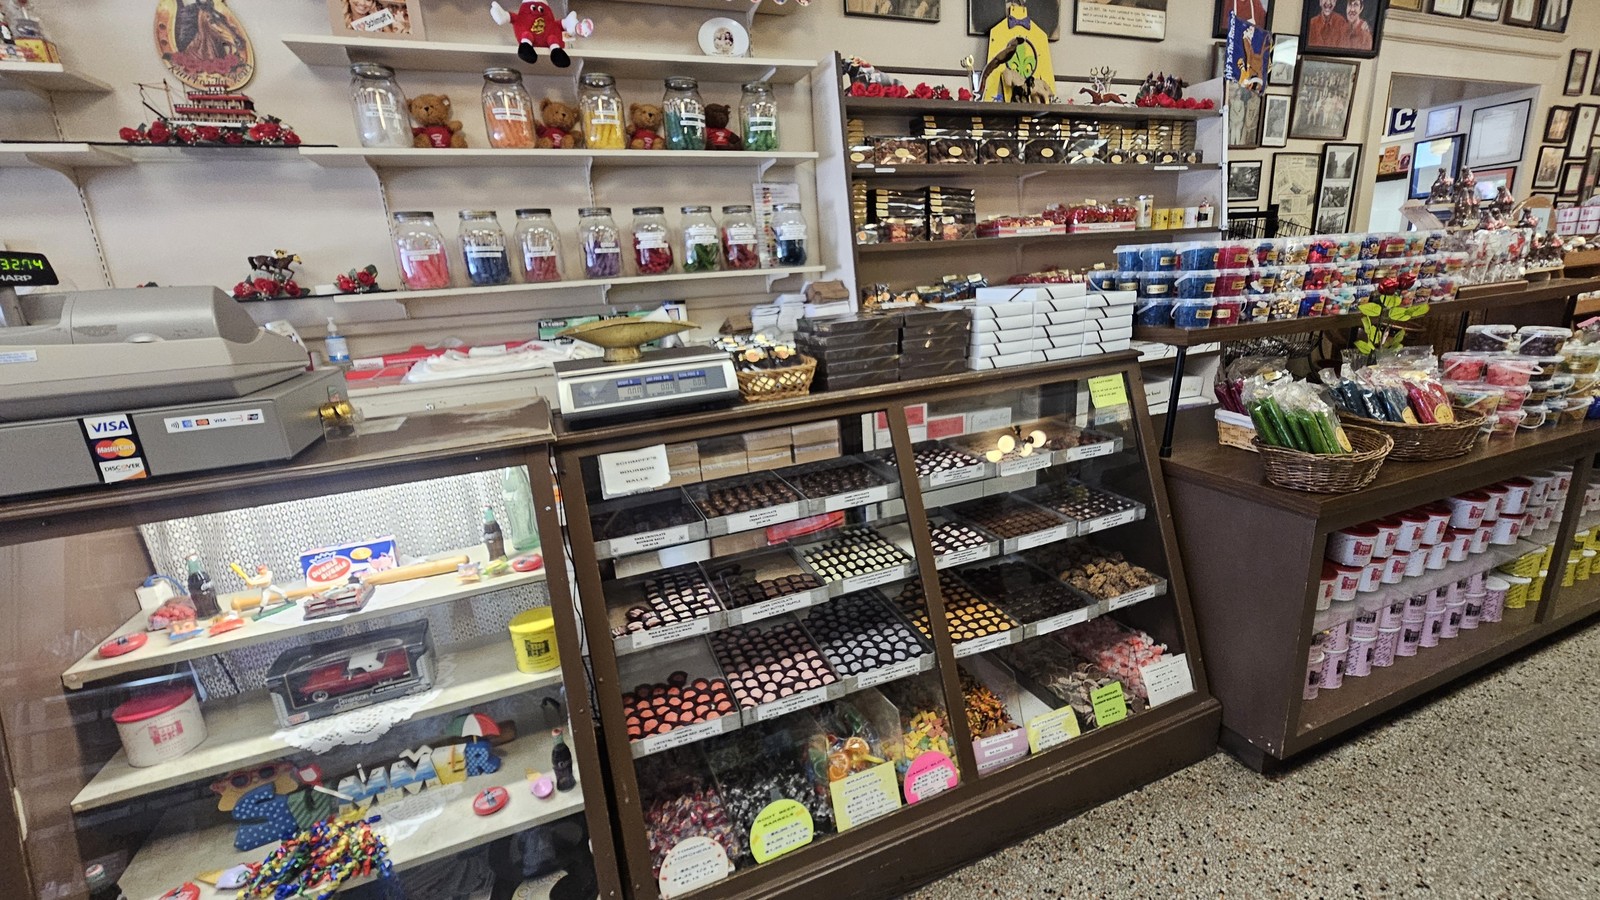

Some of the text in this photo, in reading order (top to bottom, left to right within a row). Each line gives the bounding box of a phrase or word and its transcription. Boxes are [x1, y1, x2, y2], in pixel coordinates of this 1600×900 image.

[0, 274, 32, 282] HARP
[91, 419, 129, 433] VISA
[104, 462, 141, 472] DISCOVER
[770, 596, 792, 606] CHOCOLATE
[673, 621, 694, 630] CHOCOLATE
[757, 804, 795, 824] ROOT BEER
[763, 811, 793, 827] BARRELS
